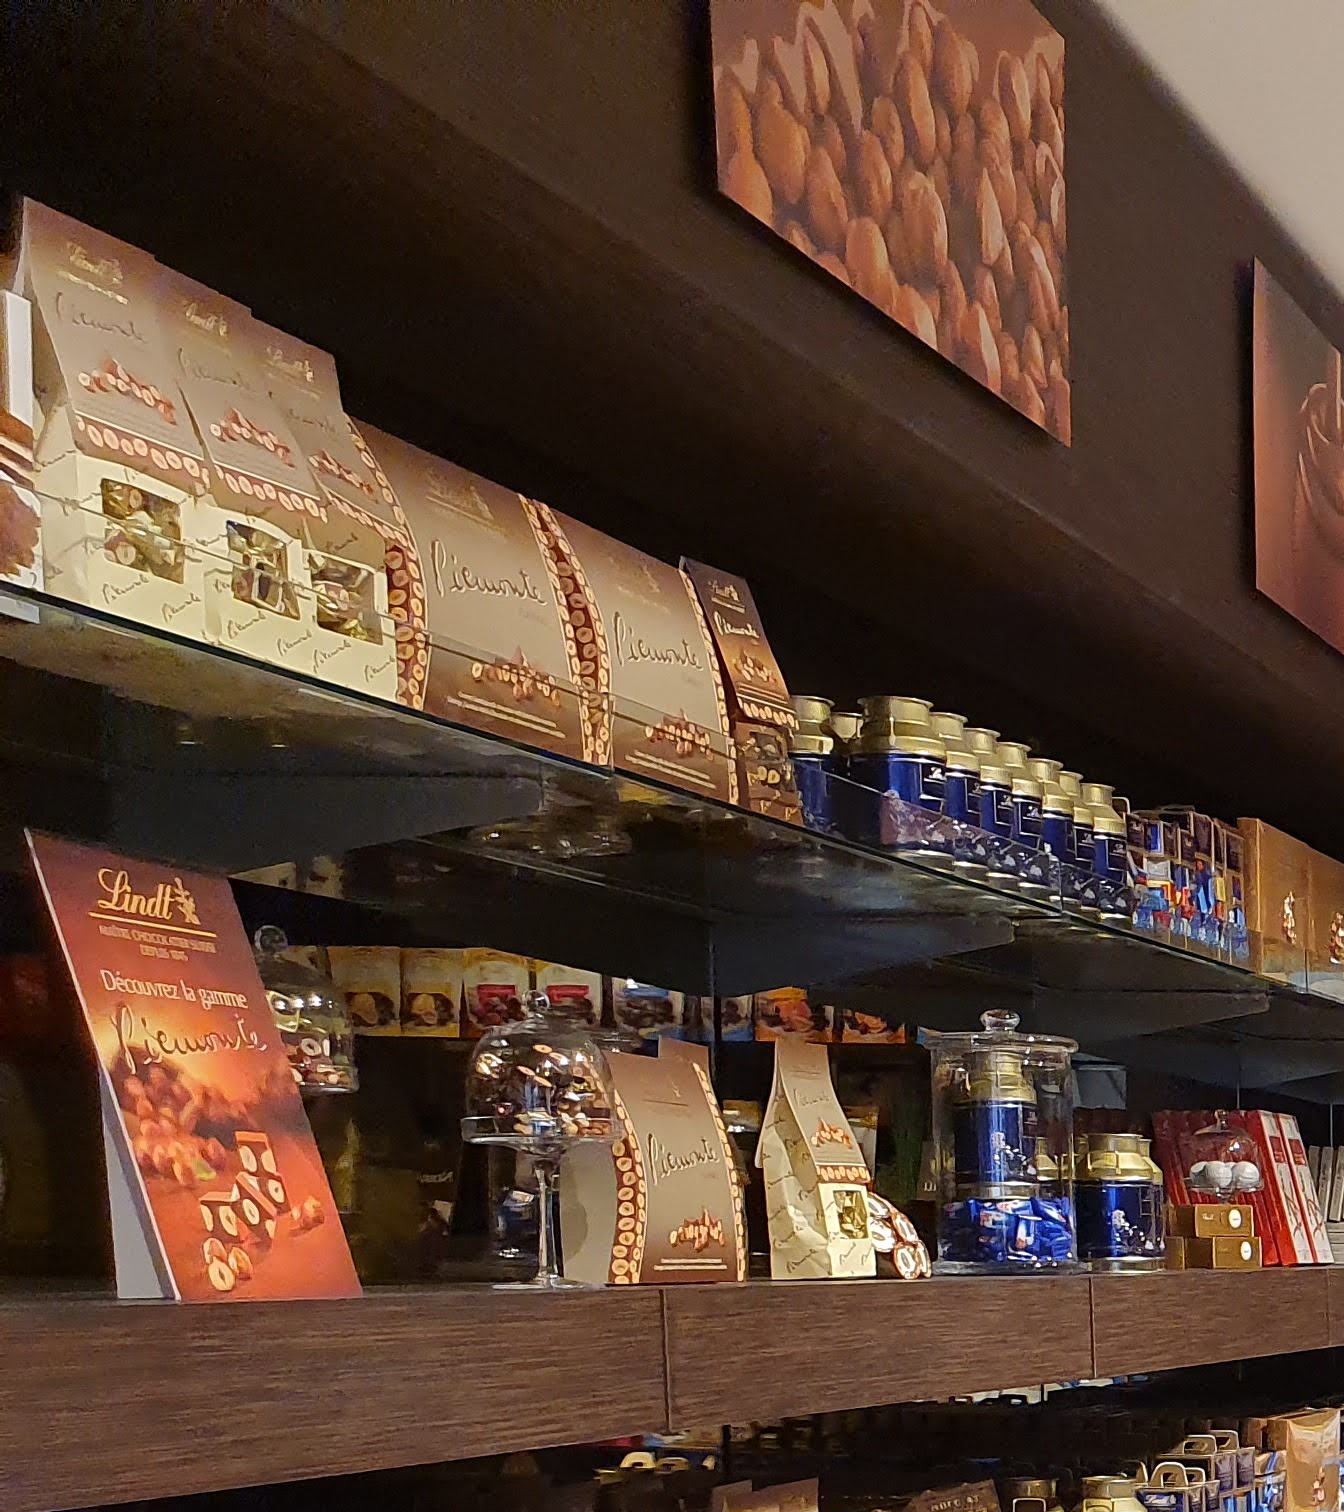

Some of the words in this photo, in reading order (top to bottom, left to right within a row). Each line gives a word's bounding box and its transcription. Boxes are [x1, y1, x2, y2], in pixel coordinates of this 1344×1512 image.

[429, 538, 549, 607] Piemonte
[612, 610, 704, 672] Piemonte
[97, 867, 174, 921] Lindt
[100, 968, 180, 1000] Découvrez
[180, 978, 196, 1002] la
[199, 987, 249, 1010] gamme
[110, 1002, 268, 1075] Piemonte
[647, 1133, 720, 1187] Piemonte
